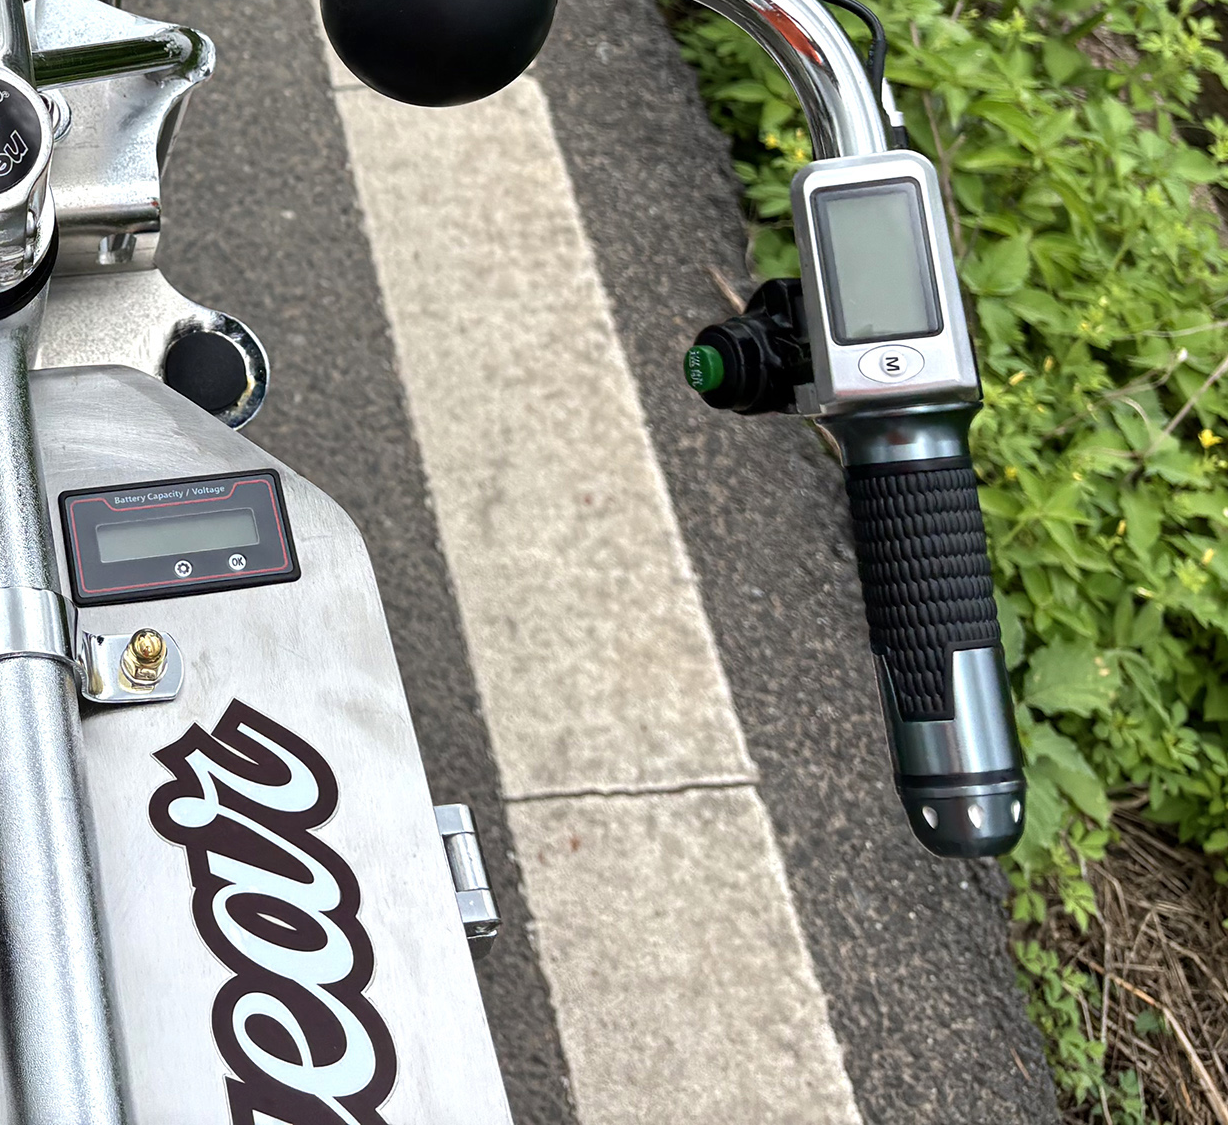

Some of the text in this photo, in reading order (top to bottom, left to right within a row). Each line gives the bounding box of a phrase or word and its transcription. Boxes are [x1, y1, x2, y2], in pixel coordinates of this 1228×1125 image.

[885, 355, 900, 372] M
[114, 495, 146, 505] Battery
[147, 490, 184, 501] Capacity
[192, 485, 225, 495] Voltage
[232, 557, 244, 567] OK
[149, 699, 397, 1125] ear
